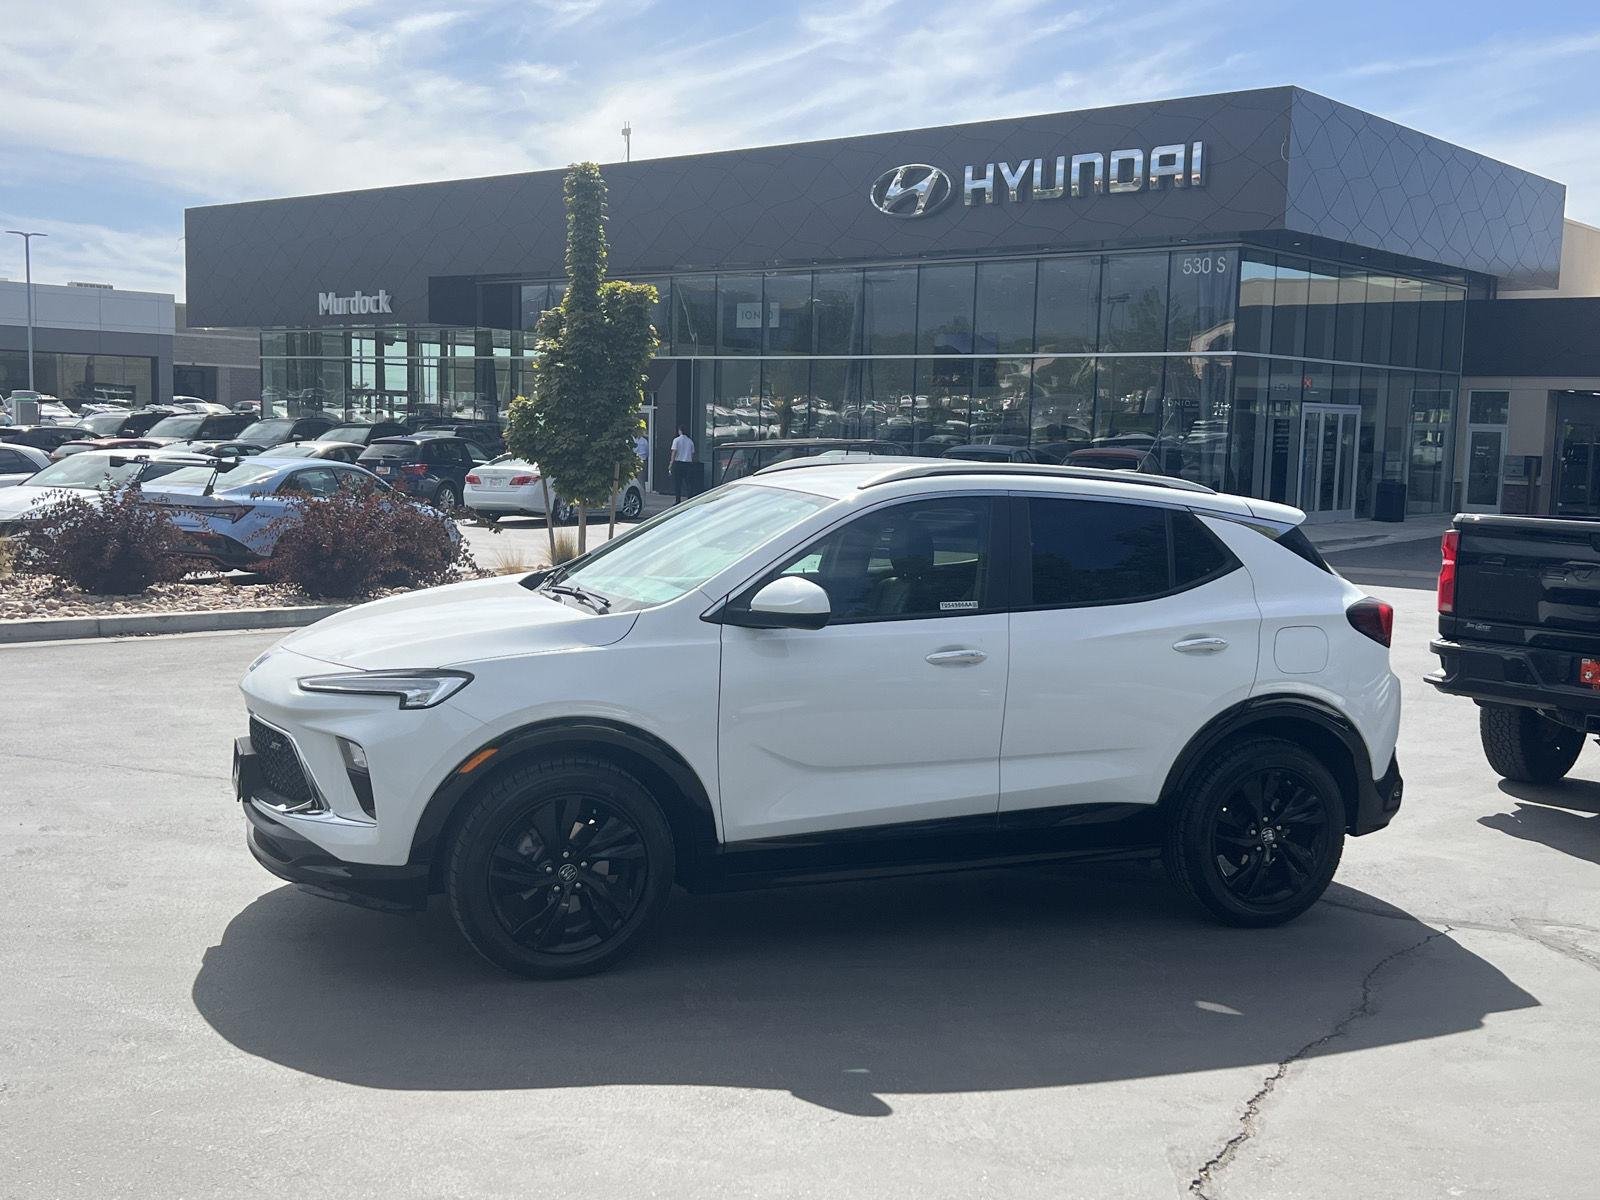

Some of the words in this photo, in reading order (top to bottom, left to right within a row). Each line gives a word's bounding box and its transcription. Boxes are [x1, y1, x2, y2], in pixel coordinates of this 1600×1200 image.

[963, 141, 1205, 206] HYUNDAI
[1183, 257, 1212, 275] 530
[1216, 256, 1226, 273] S
[319, 289, 393, 315] Murdock
[741, 310, 774, 320] ION
